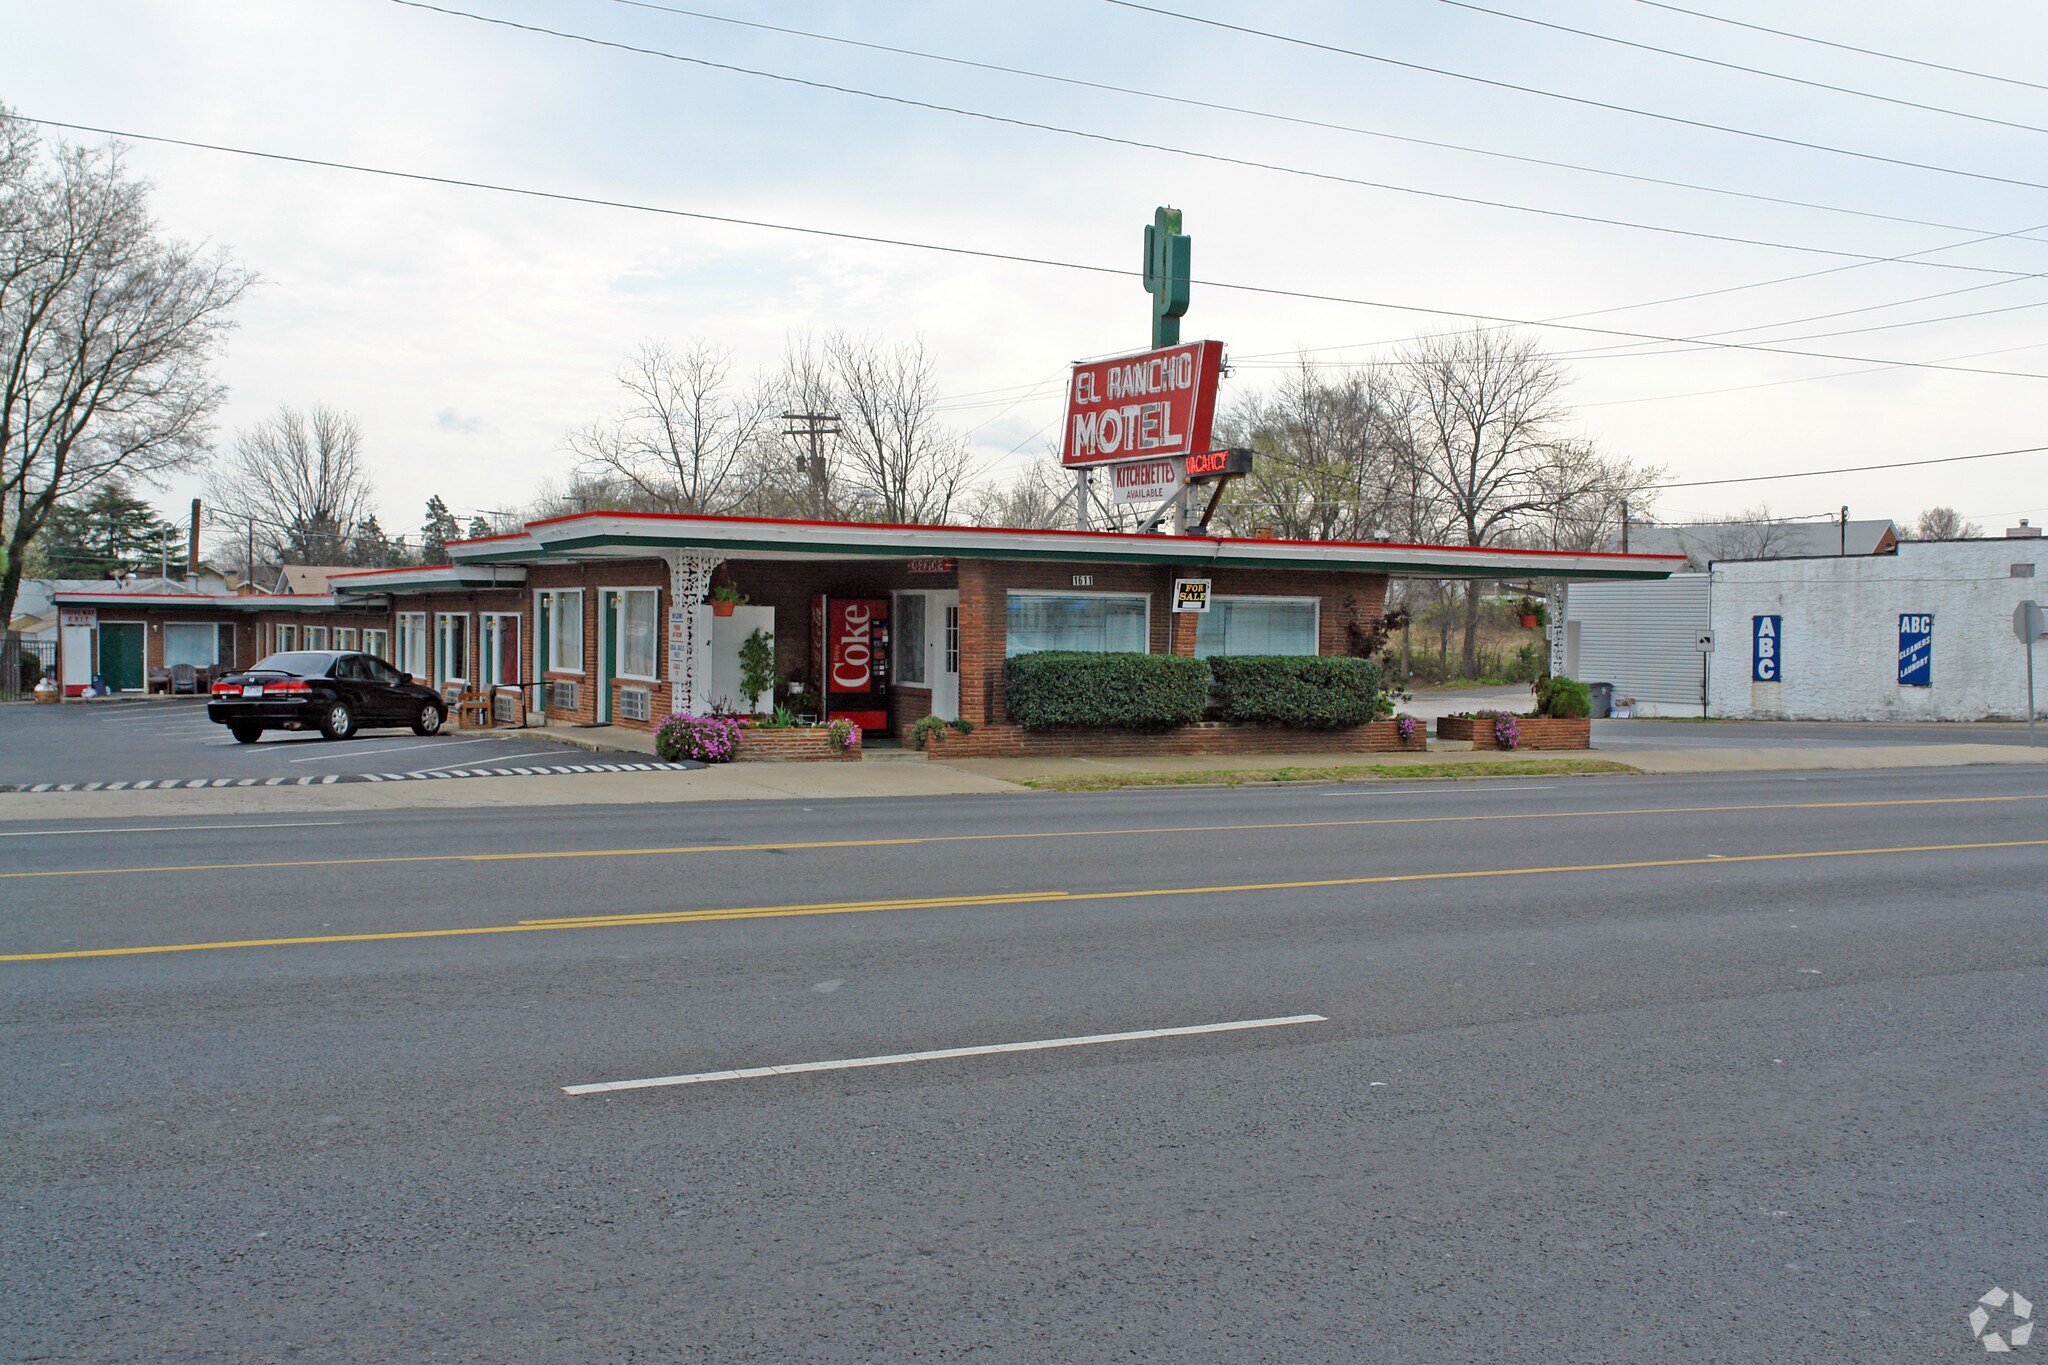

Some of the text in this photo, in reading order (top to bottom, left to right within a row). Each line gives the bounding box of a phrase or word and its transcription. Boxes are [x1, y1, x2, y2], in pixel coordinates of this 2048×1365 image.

[1076, 352, 1192, 404] EL RANCHO
[1072, 401, 1182, 457] MOTEL
[1116, 462, 1176, 488] KITCHENETTES
[1185, 451, 1229, 475] VACANCY
[1126, 487, 1163, 499] AVAILABLE
[1074, 576, 1092, 585] 1611
[1185, 584, 1204, 592] FOR
[1179, 592, 1207, 601] SALE
[1900, 616, 1930, 634] ABC
[833, 605, 870, 687] Coke
[1758, 617, 1775, 680] ABC
[1899, 635, 1931, 661] CLEANERS
[1911, 654, 1917, 662] &
[1900, 655, 1929, 679] LAUNDRY
